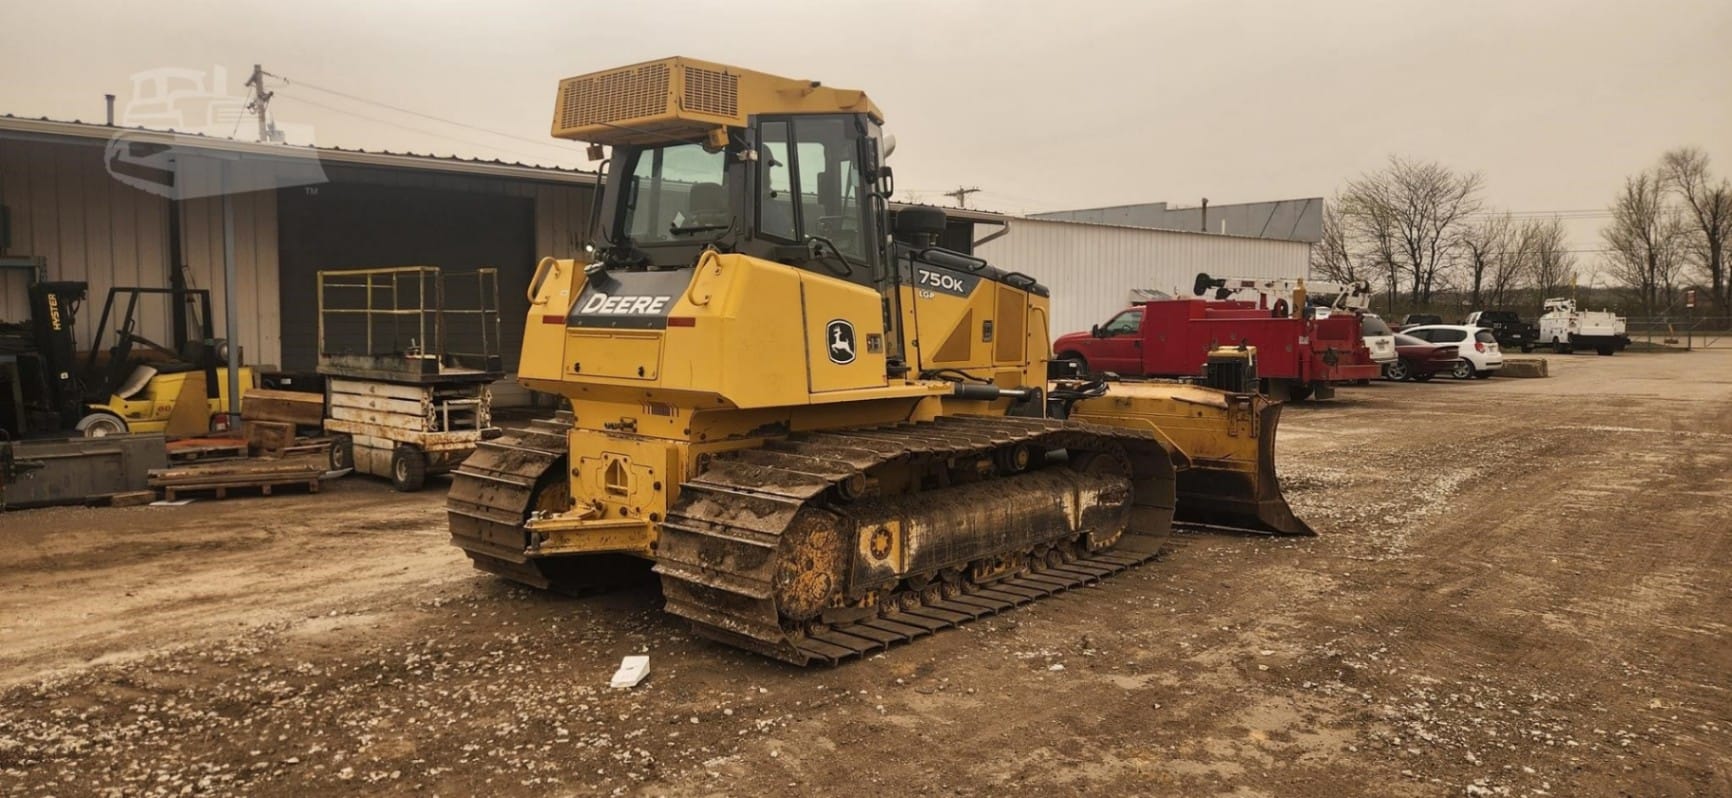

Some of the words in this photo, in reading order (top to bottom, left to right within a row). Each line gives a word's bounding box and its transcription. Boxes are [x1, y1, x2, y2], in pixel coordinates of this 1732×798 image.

[919, 269, 964, 292] 750K
[47, 293, 62, 331] HYSTER
[581, 293, 671, 314] DEERE
